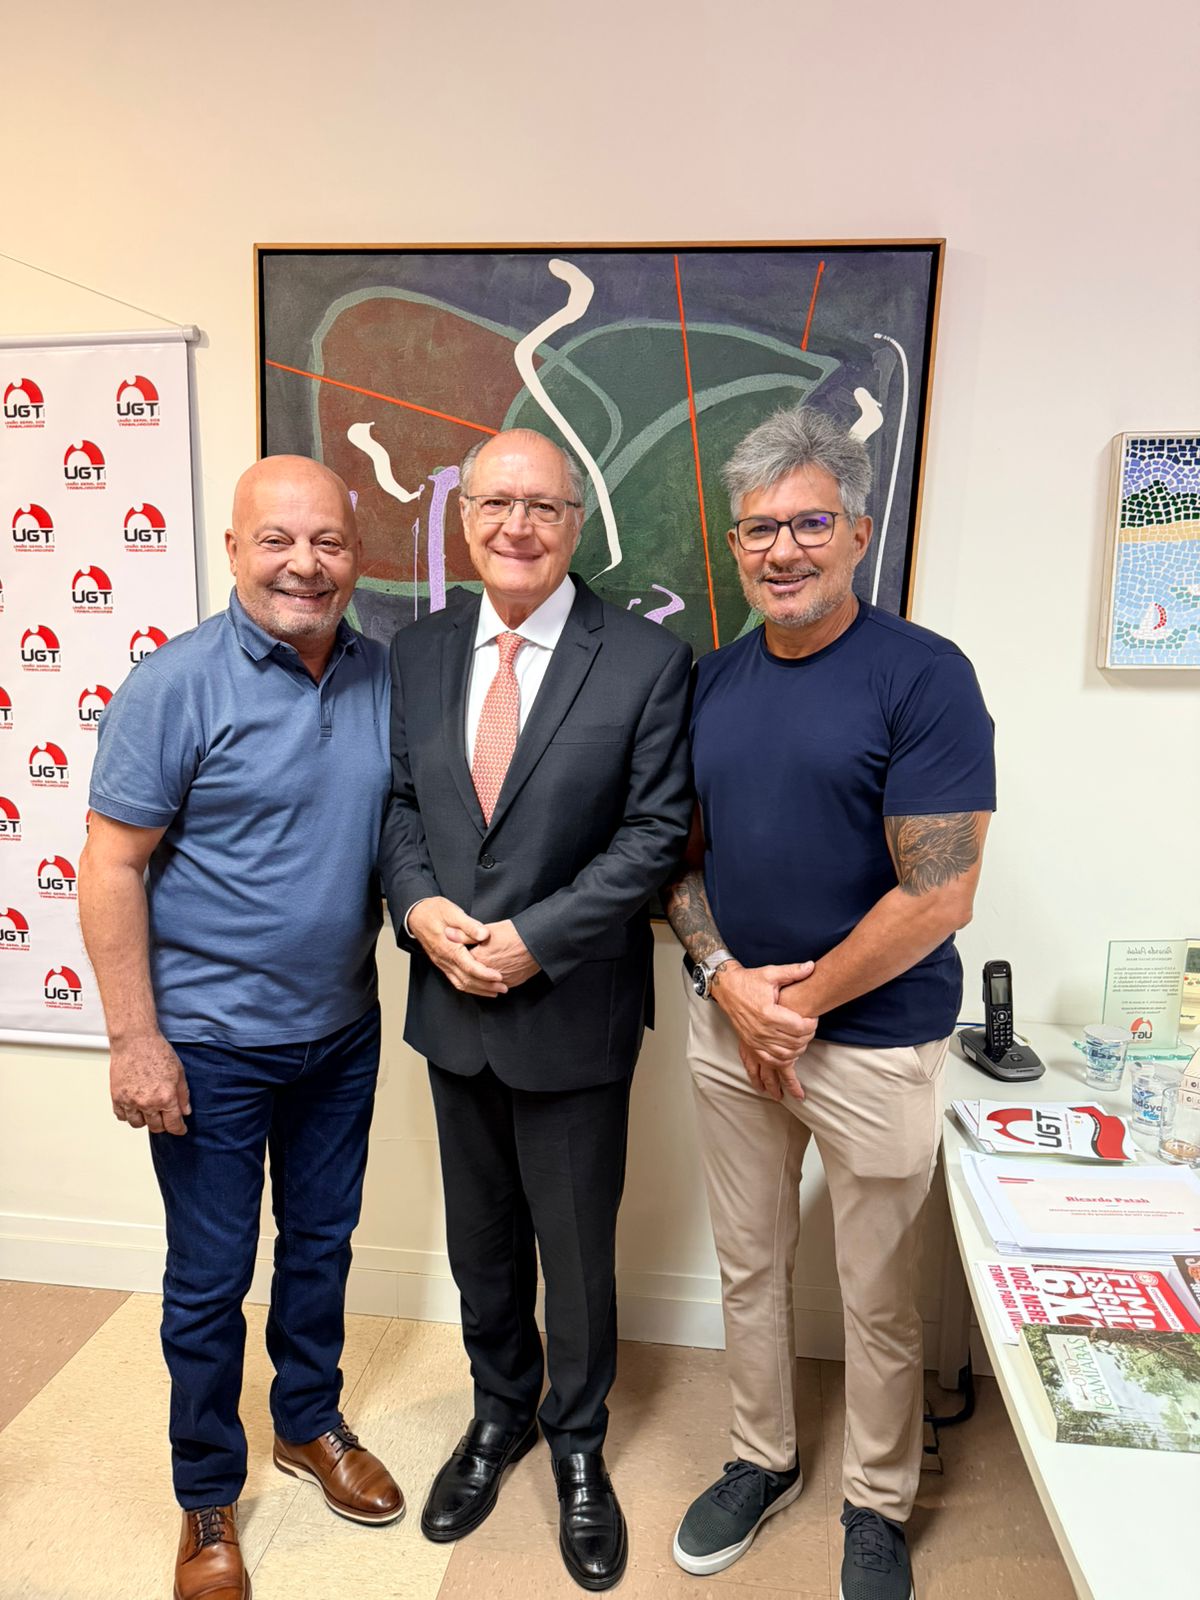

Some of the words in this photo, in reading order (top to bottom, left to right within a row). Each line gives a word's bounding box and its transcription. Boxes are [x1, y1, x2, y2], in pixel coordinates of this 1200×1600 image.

[4, 404, 44, 419] UGT
[117, 402, 159, 417] UGT
[64, 465, 105, 481] UGT
[12, 528, 54, 544] UGT
[125, 528, 166, 544] UGT
[72, 590, 112, 605] UGT
[21, 648, 60, 664] UGT
[79, 708, 103, 722] UG
[29, 765, 68, 780] UGT
[38, 877, 76, 892] UGT
[44, 987, 82, 1002] UGT
[1035, 1109, 1063, 1149] UGT
[1065, 1196, 1113, 1204] Ricardo
[1007, 1266, 1040, 1291] VOCÊ
[988, 1264, 1005, 1289] TEMPO
[1001, 1289, 1015, 1310] PARA
[1107, 1272, 1155, 1316] FIM
[1079, 1271, 1129, 1328] ESCAL
[1019, 1293, 1050, 1324] MERE
